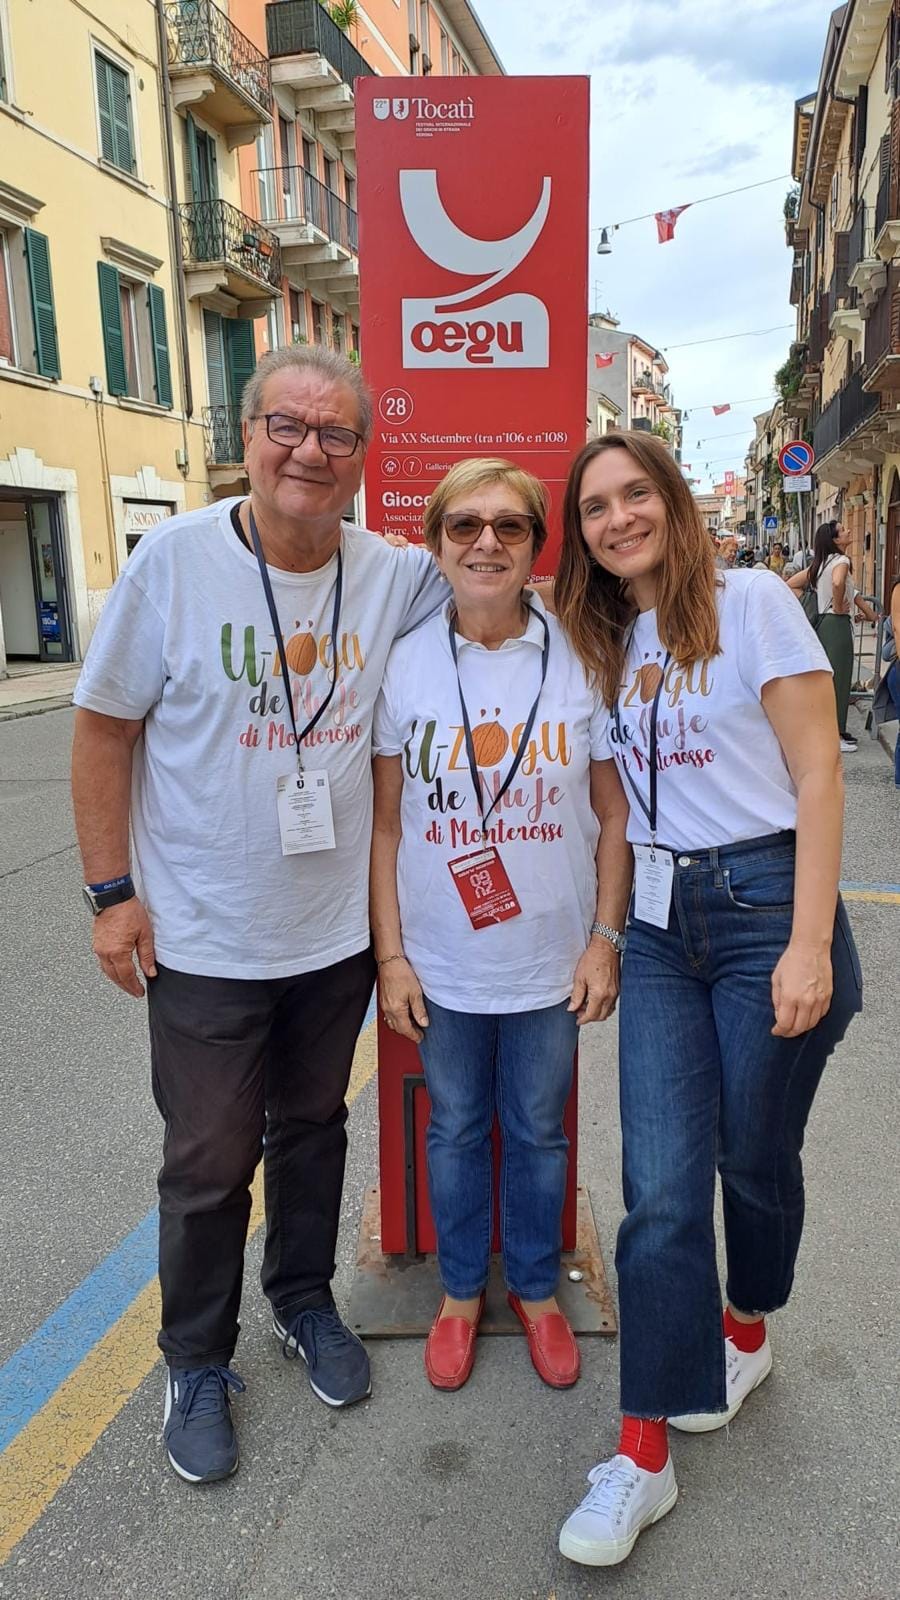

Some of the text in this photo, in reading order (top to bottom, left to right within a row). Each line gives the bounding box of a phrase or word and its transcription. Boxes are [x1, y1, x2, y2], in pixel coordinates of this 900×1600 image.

[411, 96, 475, 119] Tocatì
[386, 397, 406, 416] 28
[380, 432, 398, 444] Via
[401, 432, 417, 444] XX
[420, 432, 472, 444] Settembre
[474, 432, 493, 445] (tra
[527, 435, 532, 443] e
[409, 461, 415, 472] 7
[382, 512, 425, 522] Associazi
[250, 681, 285, 717] de
[239, 723, 263, 748] di
[632, 746, 718, 771] Mterosso
[428, 777, 466, 813] de
[425, 818, 564, 848] di Monterosso
